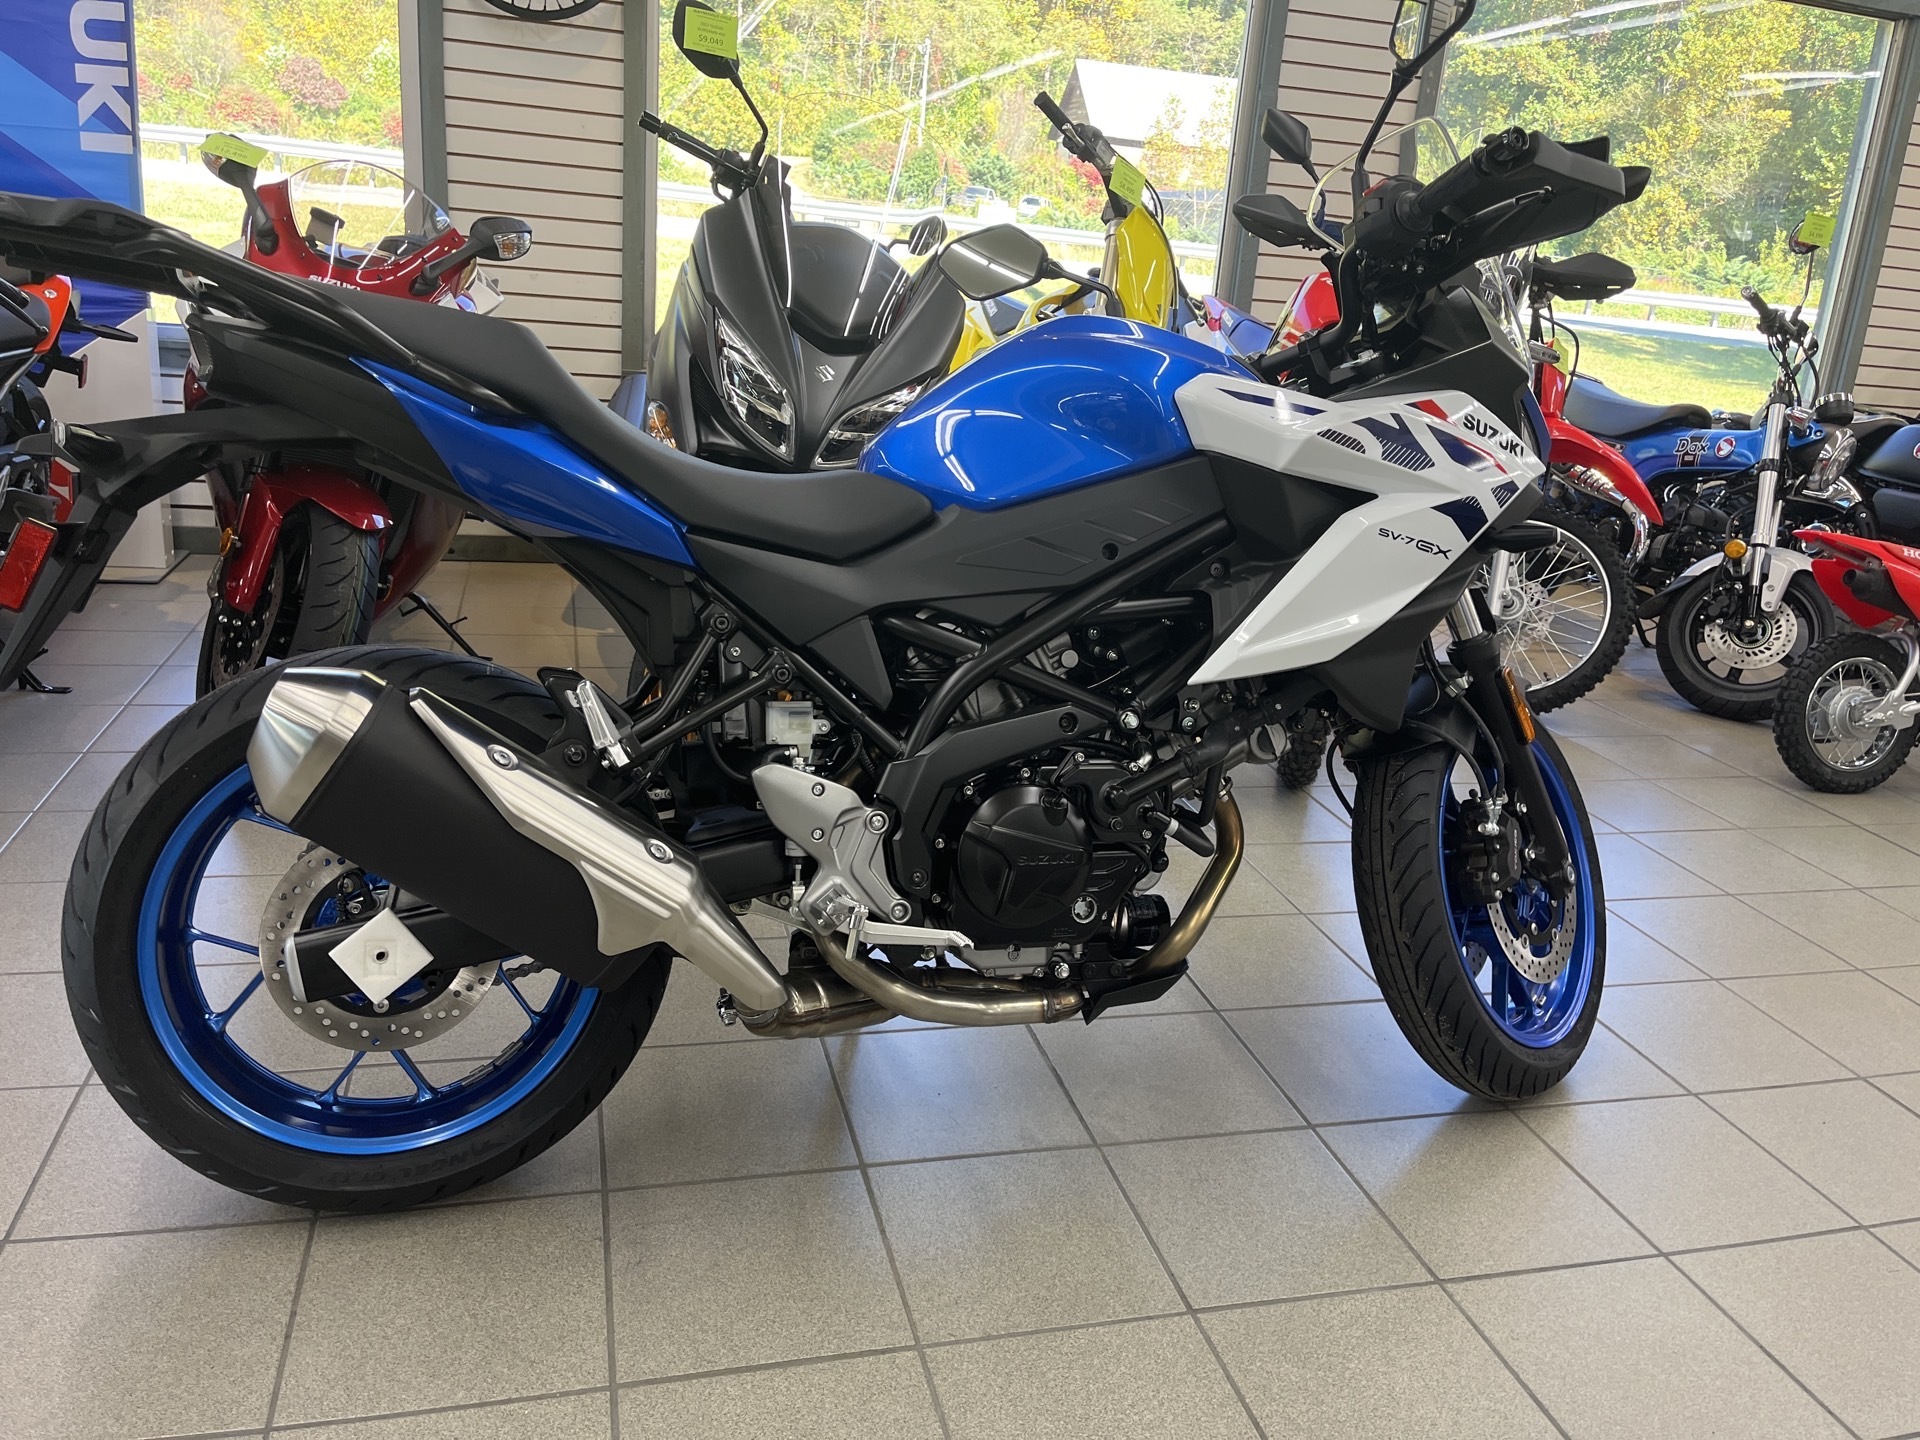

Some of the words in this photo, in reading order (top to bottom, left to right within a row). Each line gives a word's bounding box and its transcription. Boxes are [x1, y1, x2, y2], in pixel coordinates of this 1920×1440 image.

[698, 34, 724, 46] $9,049
[1462, 413, 1524, 458] SUZUKI
[1673, 437, 1710, 454] Dax
[1378, 528, 1452, 560] SV-7GX
[1017, 853, 1075, 866] SUZUKI
